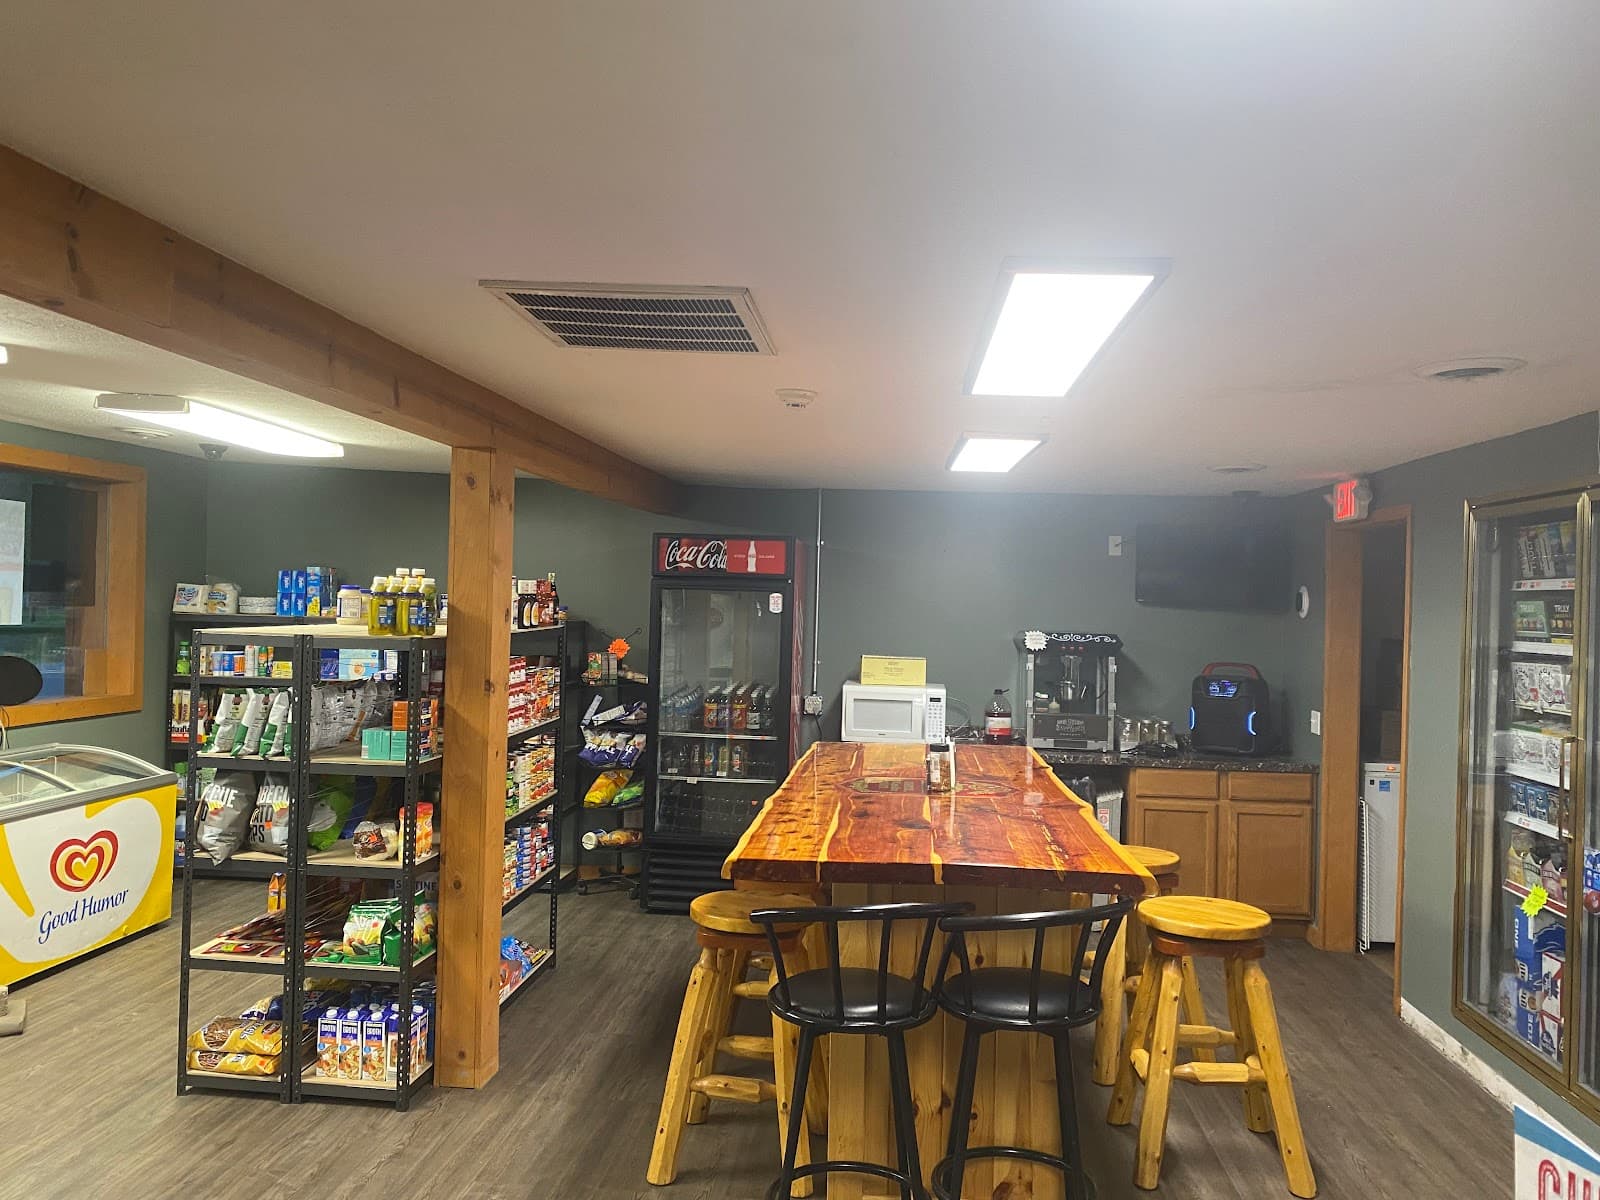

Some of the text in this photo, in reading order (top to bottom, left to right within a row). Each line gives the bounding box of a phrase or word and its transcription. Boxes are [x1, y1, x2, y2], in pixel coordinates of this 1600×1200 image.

[1337, 480, 1357, 519] EXIT
[1554, 604, 1569, 612] TRULY
[38, 889, 129, 945] Good Humor
